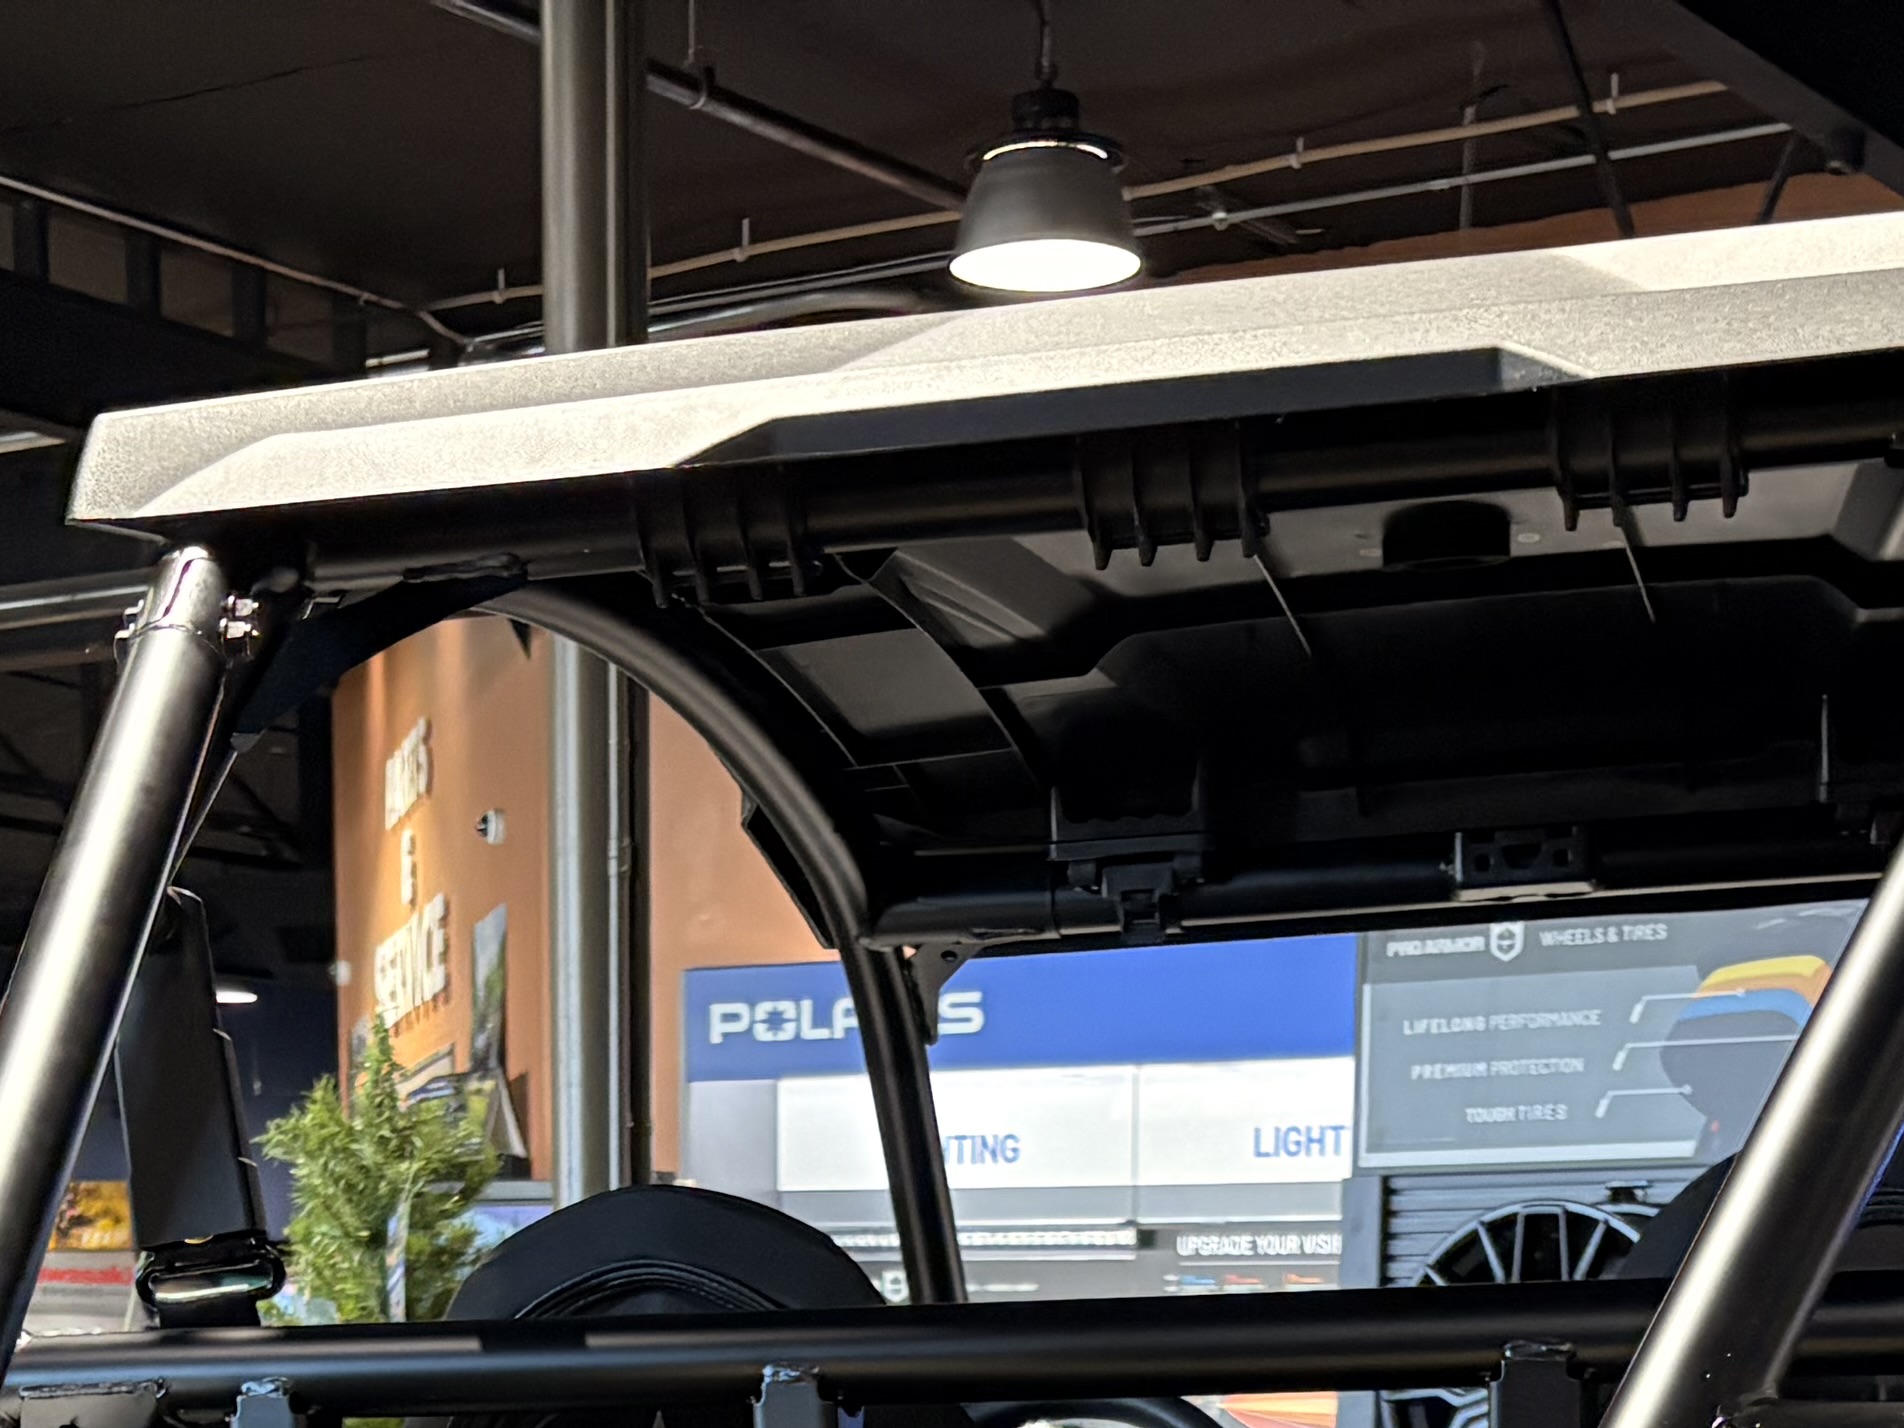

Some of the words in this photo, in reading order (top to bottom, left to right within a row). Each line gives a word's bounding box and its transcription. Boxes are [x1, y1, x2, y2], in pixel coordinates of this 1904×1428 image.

[1539, 928, 1605, 946] WHEELS
[1607, 926, 1618, 943] &
[1622, 923, 1669, 941] TIRES
[709, 991, 985, 1044] POLAS
[1402, 1016, 1486, 1036] LIFELONG
[1488, 1009, 1602, 1031] PERFORMANCE
[1410, 1062, 1488, 1080] PREMIUM
[1490, 1057, 1585, 1076] PROTECTION
[1465, 1106, 1516, 1123] TOUGH
[1518, 1103, 1568, 1120] TIRES
[1176, 1234, 1254, 1256] UPGRADE
[1255, 1234, 1301, 1255] YOUR
